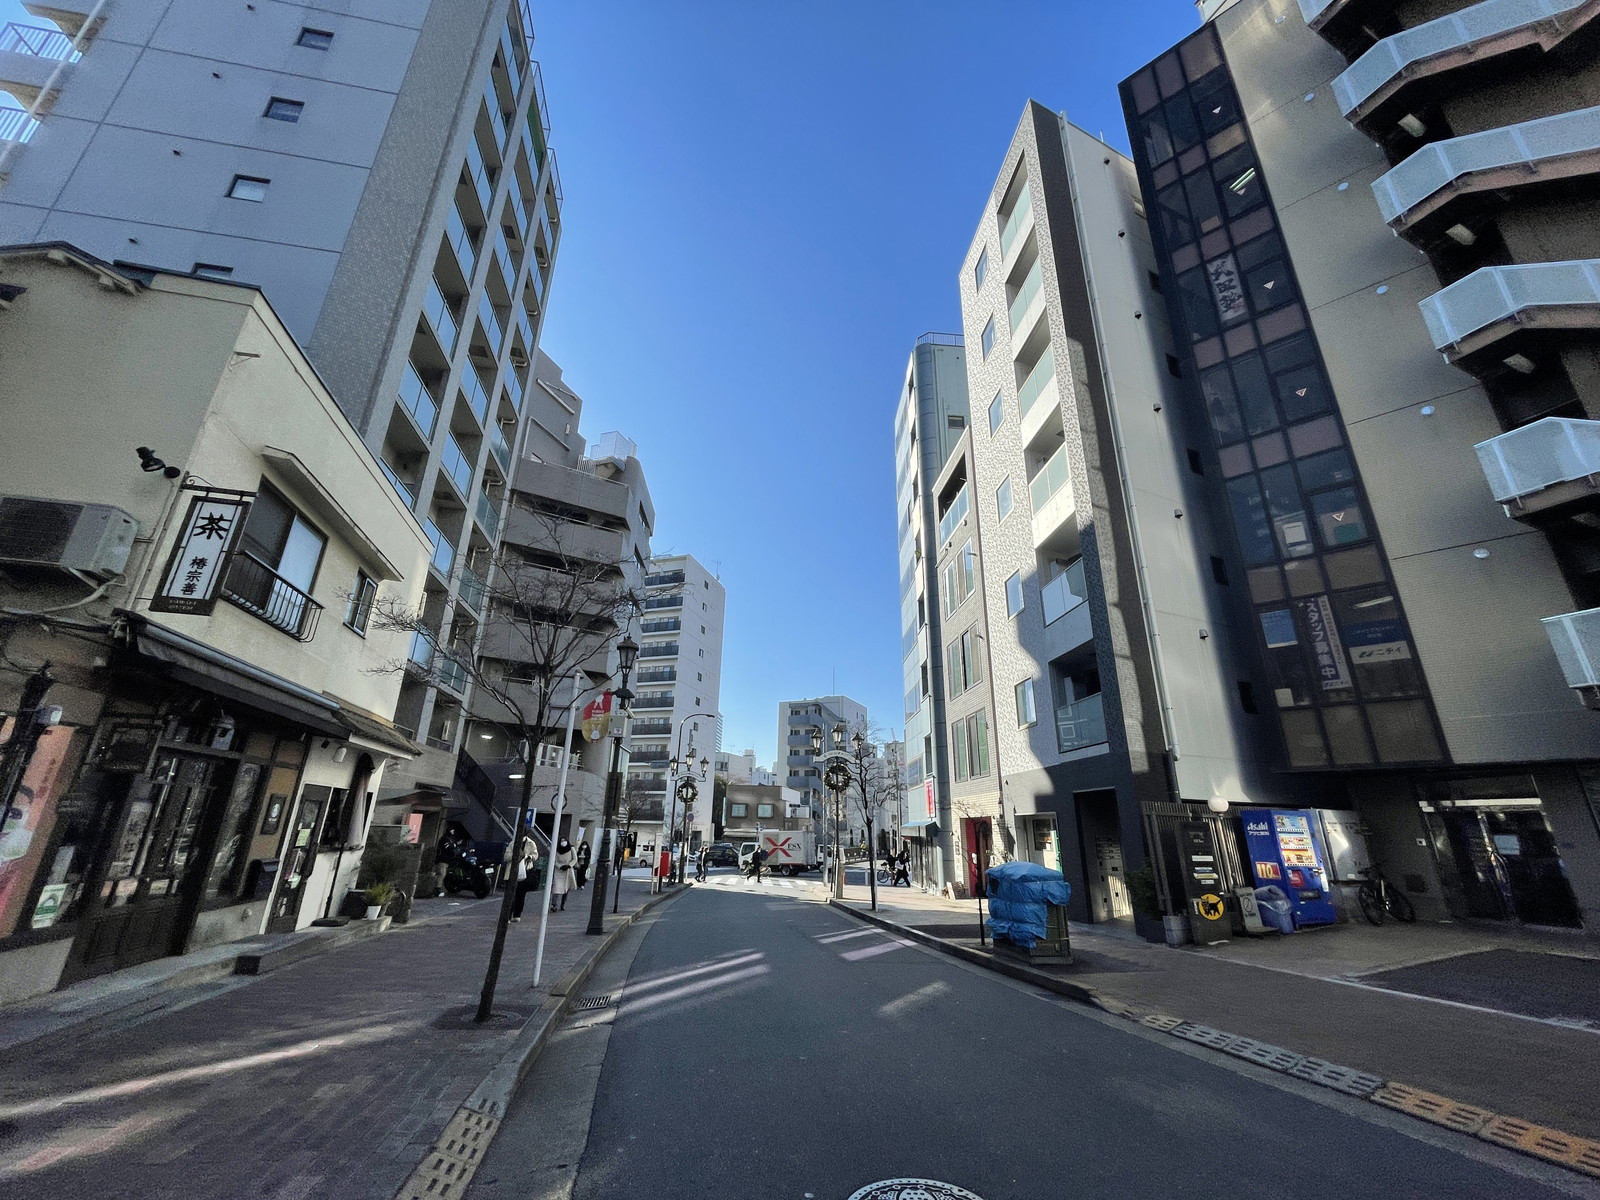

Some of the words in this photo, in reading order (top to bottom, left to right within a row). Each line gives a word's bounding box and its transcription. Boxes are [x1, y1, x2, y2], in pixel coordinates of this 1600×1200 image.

[193, 511, 233, 540] 茶
[181, 556, 208, 596] 椿宗善
[1247, 822, 1269, 831] Asahi
[1257, 864, 1273, 879] 110
